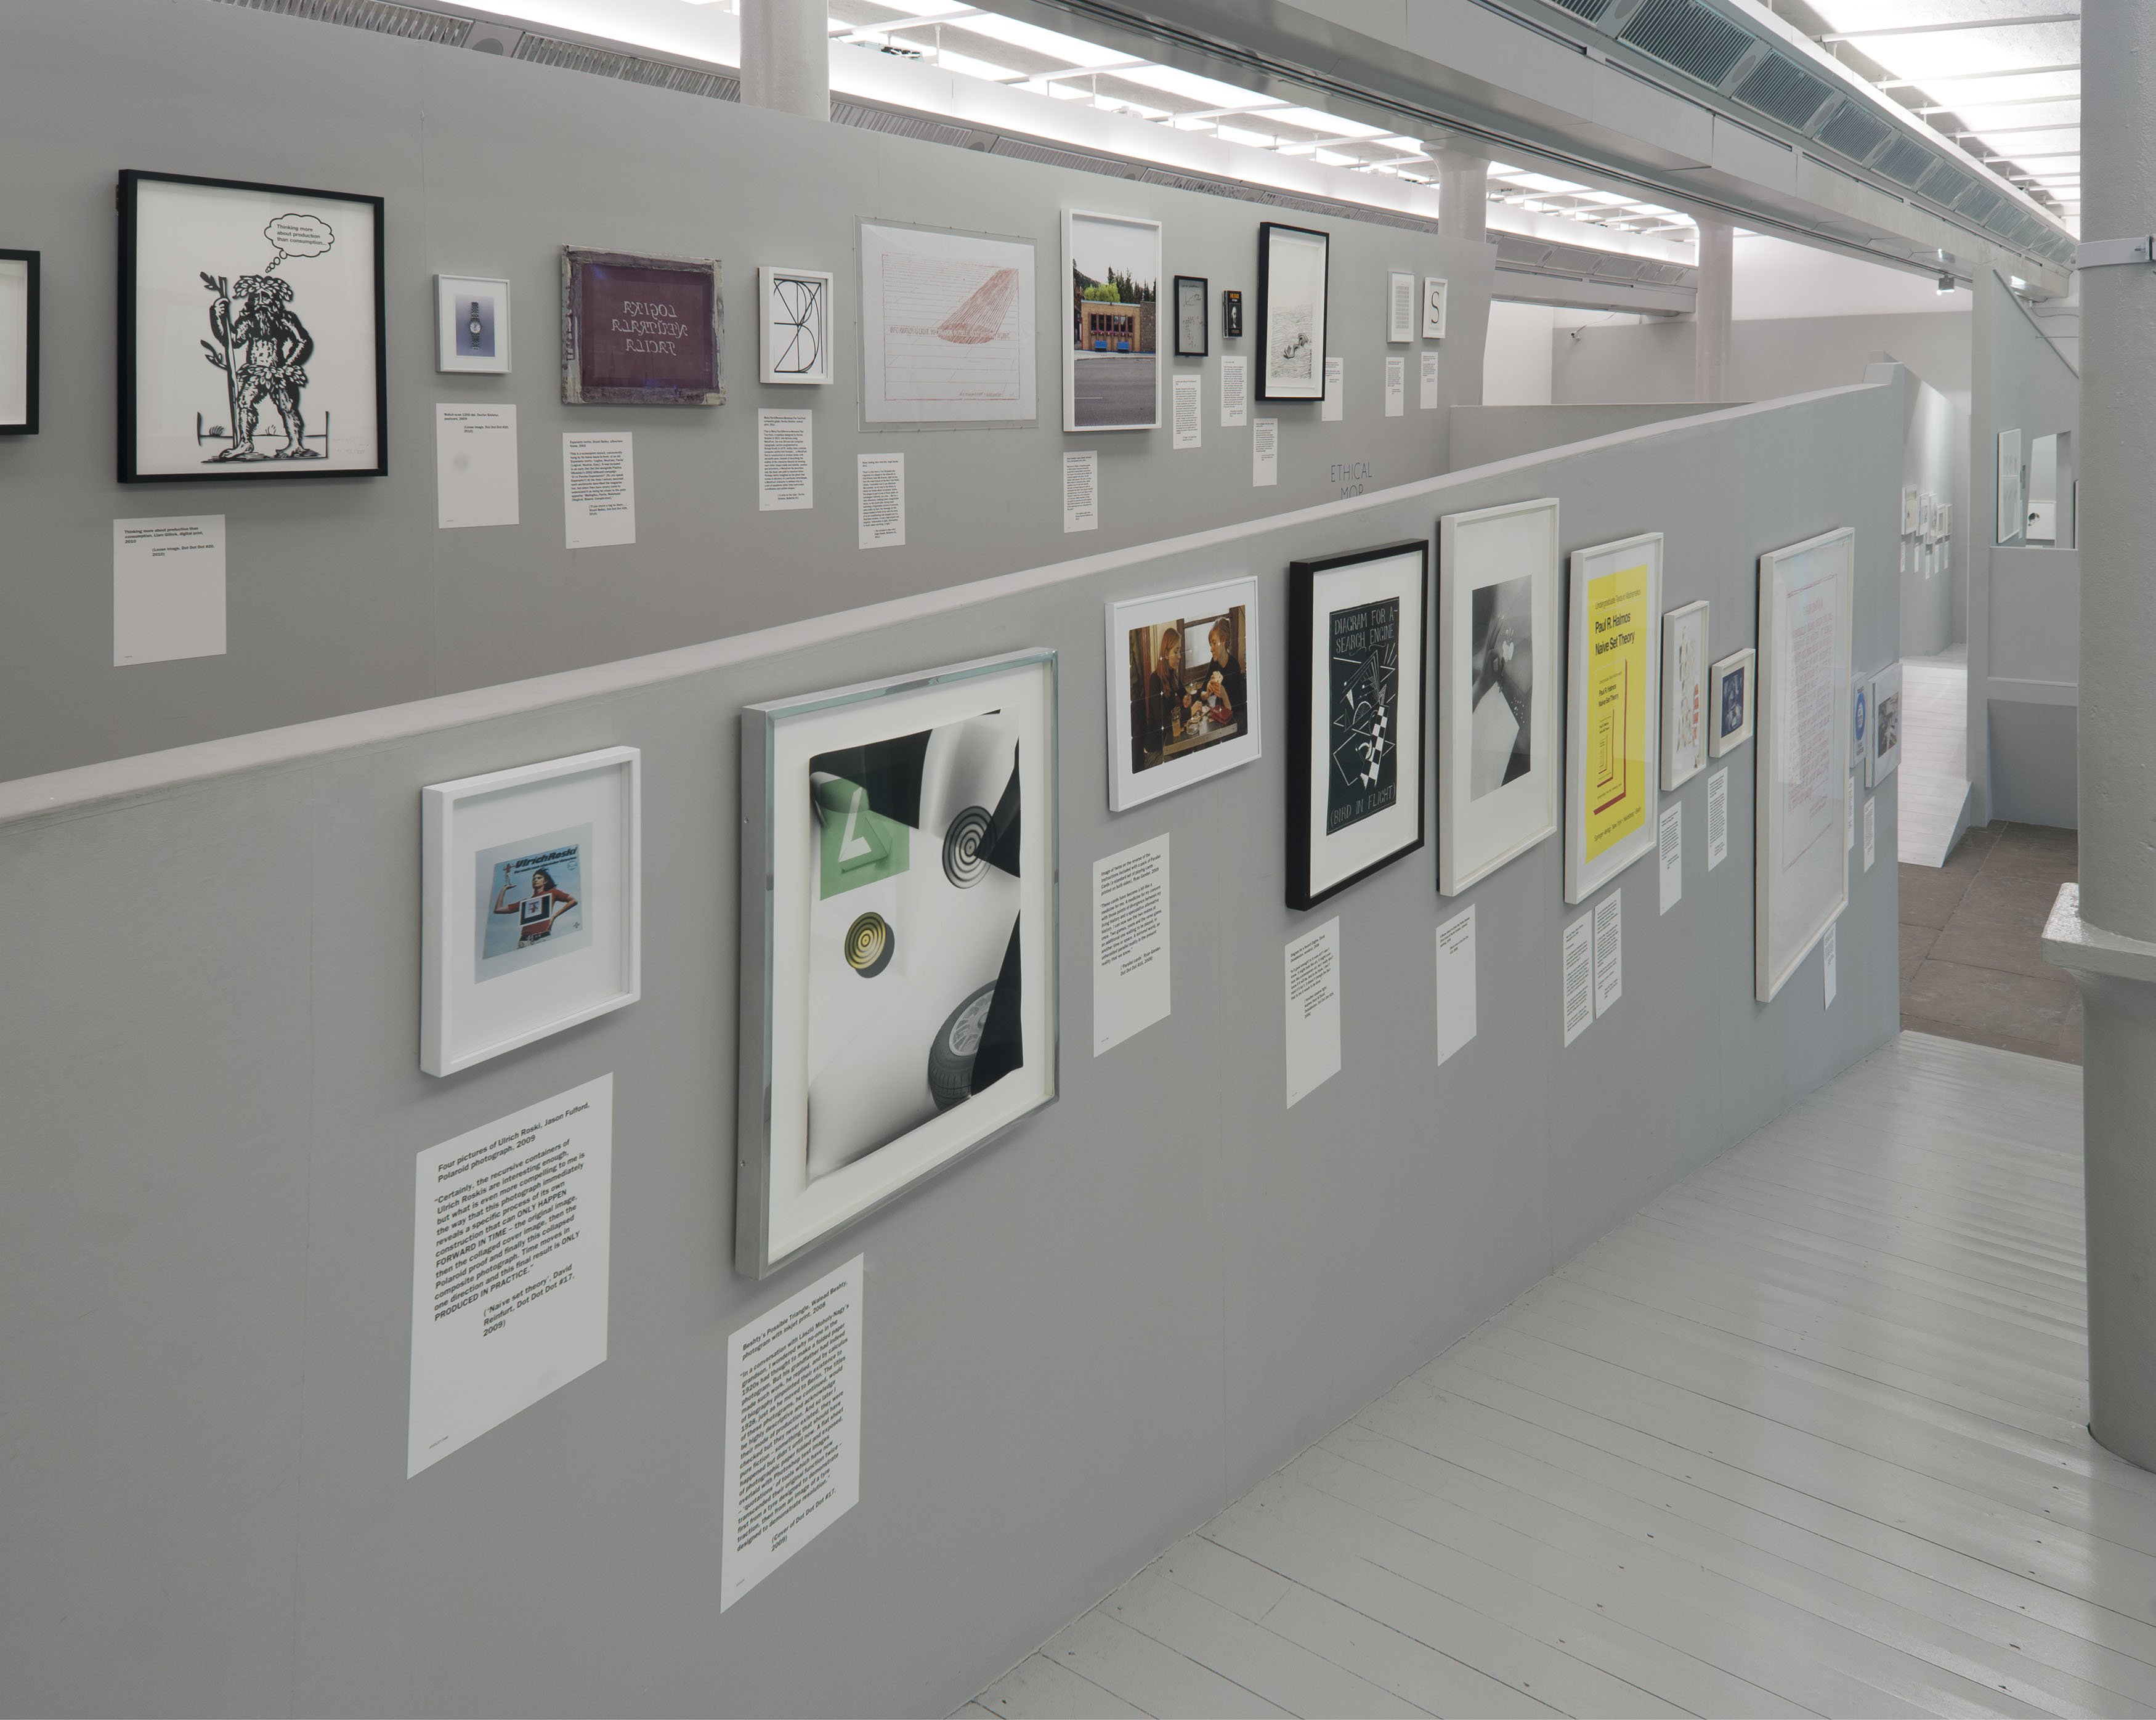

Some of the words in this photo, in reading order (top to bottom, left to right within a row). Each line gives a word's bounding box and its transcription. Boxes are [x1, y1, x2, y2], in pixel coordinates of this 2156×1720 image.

[1431, 291, 1440, 325] S
[1331, 462, 1372, 482] ETHICAL
[1335, 612, 1368, 635] DIAGRAM
[1371, 608, 1385, 626] FOR
[1335, 631, 1366, 654] SEARCH
[1370, 623, 1394, 644] ENGINE
[1595, 618, 1607, 634] Paul
[1607, 617, 1612, 630] R.
[1613, 612, 1631, 628] Halmos
[1595, 640, 1610, 655] Naive
[1610, 636, 1618, 650] Set
[1619, 631, 1635, 646] Theory
[1330, 805, 1352, 828] (BIRD
[1356, 798, 1364, 814] IN
[1368, 782, 1396, 809] FLIGHT)
[438, 1160, 456, 1172] Four
[456, 1146, 488, 1166] pictures
[489, 1140, 497, 1150] of
[498, 1132, 519, 1146] Ulrich
[521, 1122, 543, 1137] Roski,
[544, 1113, 564, 1127] Jason
[565, 1102, 590, 1118] Fulford,
[438, 1162, 469, 1183] Polaroid
[471, 1145, 515, 1170] photograph,
[516, 1134, 536, 1148] 2009
[476, 1177, 489, 1187] the
[490, 1161, 524, 1180] recursive
[524, 1143, 562, 1164] containers
[562, 1138, 570, 1147] of
[436, 1225, 450, 1236] the
[451, 1218, 466, 1229] way
[468, 1209, 484, 1221] that
[485, 1202, 500, 1213] this
[501, 1182, 541, 1207] photograph
[543, 1162, 584, 1186] immediately
[437, 1199, 460, 1215] Ulrich
[461, 1187, 487, 1204] Roskis
[488, 1182, 501, 1191] are
[502, 1162, 541, 1185] interesting
[541, 1150, 569, 1167] enough,
[437, 1214, 450, 1225] but
[452, 1204, 471, 1218] what
[472, 1201, 479, 1209] is
[480, 1192, 498, 1205] even
[500, 1183, 518, 1196] more
[519, 1164, 557, 1187] compelling
[567, 1156, 578, 1165] me
[435, 1230, 484, 1257] construction
[485, 1221, 501, 1233] that
[502, 1214, 516, 1225] can
[517, 1203, 537, 1218] ONLY
[538, 1188, 567, 1208] HAPPEN
[436, 1229, 464, 1247] reveals
[472, 1212, 501, 1230] specific
[502, 1198, 531, 1217] process
[532, 1191, 540, 1201] of
[540, 1188, 549, 1197] its
[551, 1181, 565, 1192] own
[436, 1243, 476, 1268] FORWARD
[478, 1238, 486, 1247] IN
[487, 1227, 507, 1242] TIME
[514, 1219, 526, 1230] the
[527, 1204, 553, 1223] original
[554, 1196, 578, 1210] image,
[434, 1276, 474, 1300] composite
[476, 1254, 520, 1280] photograph.
[521, 1243, 539, 1256] Time
[540, 1231, 562, 1247] moves
[435, 1265, 453, 1279] then
[455, 1259, 468, 1269] the
[469, 1240, 501, 1262] collaged
[502, 1231, 523, 1246] cover
[524, 1220, 547, 1235] image,
[548, 1211, 564, 1222] then
[565, 1204, 577, 1214] the
[435, 1268, 467, 1289] Polaroid
[468, 1257, 488, 1274] proof
[489, 1249, 503, 1262] and
[504, 1240, 525, 1254] finally
[527, 1232, 541, 1243] this
[541, 1214, 575, 1236] collapsed
[434, 1300, 448, 1311] one
[450, 1281, 484, 1303] direction
[485, 1272, 499, 1284] and
[500, 1265, 514, 1276] this
[516, 1256, 532, 1268] final
[532, 1245, 553, 1260] result
[561, 1230, 580, 1245] ONLY
[511, 1290, 524, 1301] set
[553, 1263, 572, 1280] David
[434, 1293, 479, 1321] PRODUCED
[480, 1288, 488, 1297] IN
[484, 1305, 515, 1326] Reinfurt,
[517, 1297, 530, 1308] Dot
[531, 1289, 544, 1301] Dot
[545, 1281, 557, 1294] Dot
[559, 1273, 575, 1285] #17,
[766, 1318, 788, 1336] Possible
[811, 1291, 830, 1307] Walead
[830, 1281, 848, 1295] Beshty,
[482, 1319, 506, 1337] 2009)
[742, 1338, 771, 1361] photogram
[771, 1330, 783, 1341] with
[783, 1320, 798, 1333] inkjet
[798, 1312, 812, 1324] print,
[813, 1301, 826, 1315] 2008
